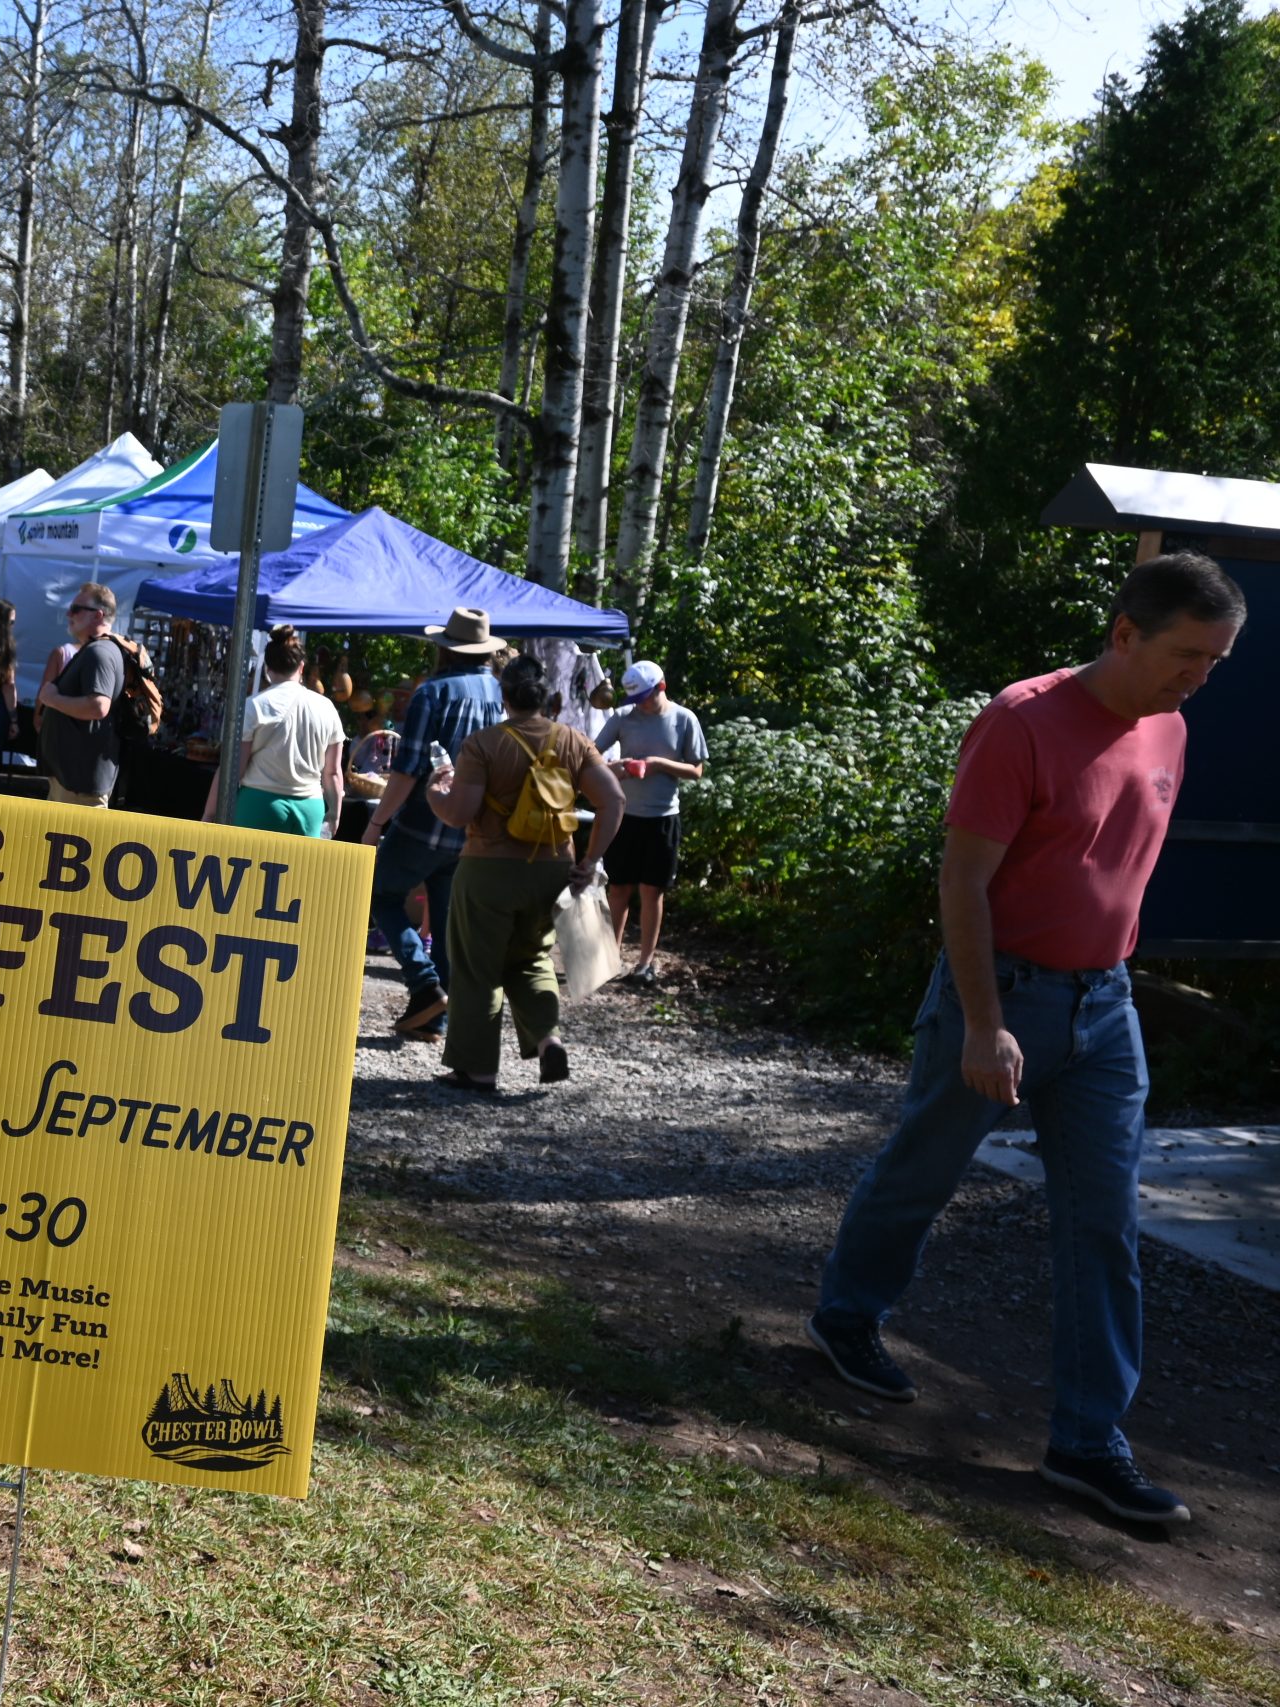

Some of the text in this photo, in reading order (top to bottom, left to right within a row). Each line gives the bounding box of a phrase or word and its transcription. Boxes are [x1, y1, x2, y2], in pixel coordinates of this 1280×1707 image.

[39, 831, 303, 924] BOWL
[1, 1060, 315, 1167] SEPTEMBER
[19, 1277, 111, 1307] Music
[51, 1313, 108, 1339] Fun
[12, 1339, 101, 1370] More!
[146, 1417, 280, 1446] CHESTER BOWL
